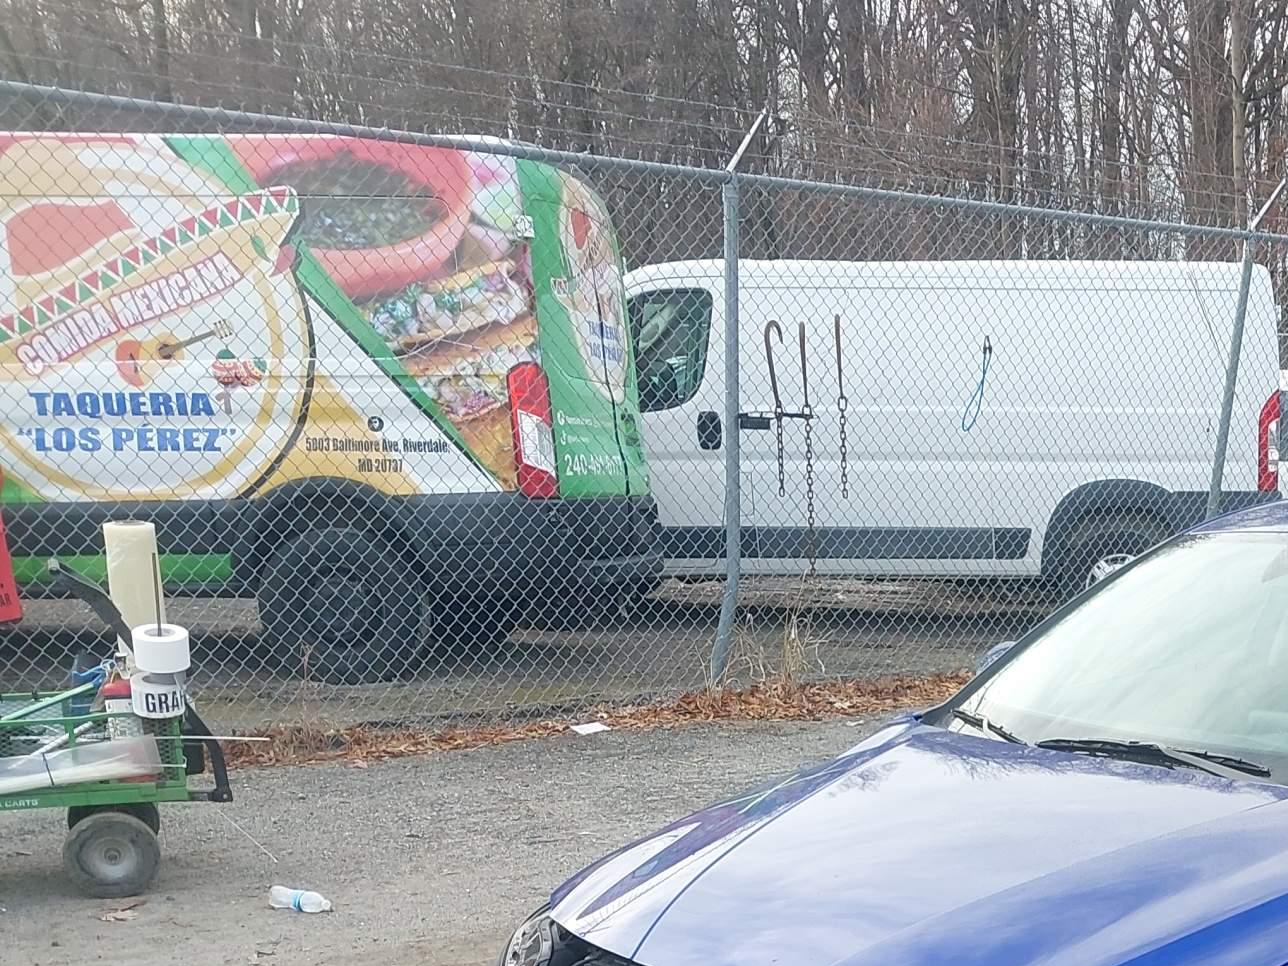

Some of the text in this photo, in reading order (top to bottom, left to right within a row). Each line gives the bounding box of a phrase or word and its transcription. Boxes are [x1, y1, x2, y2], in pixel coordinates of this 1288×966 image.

[16, 250, 244, 376] COMIDA MEXICANA
[28, 392, 216, 418] TAQUERIA
[332, 438, 380, 452] Baltimore
